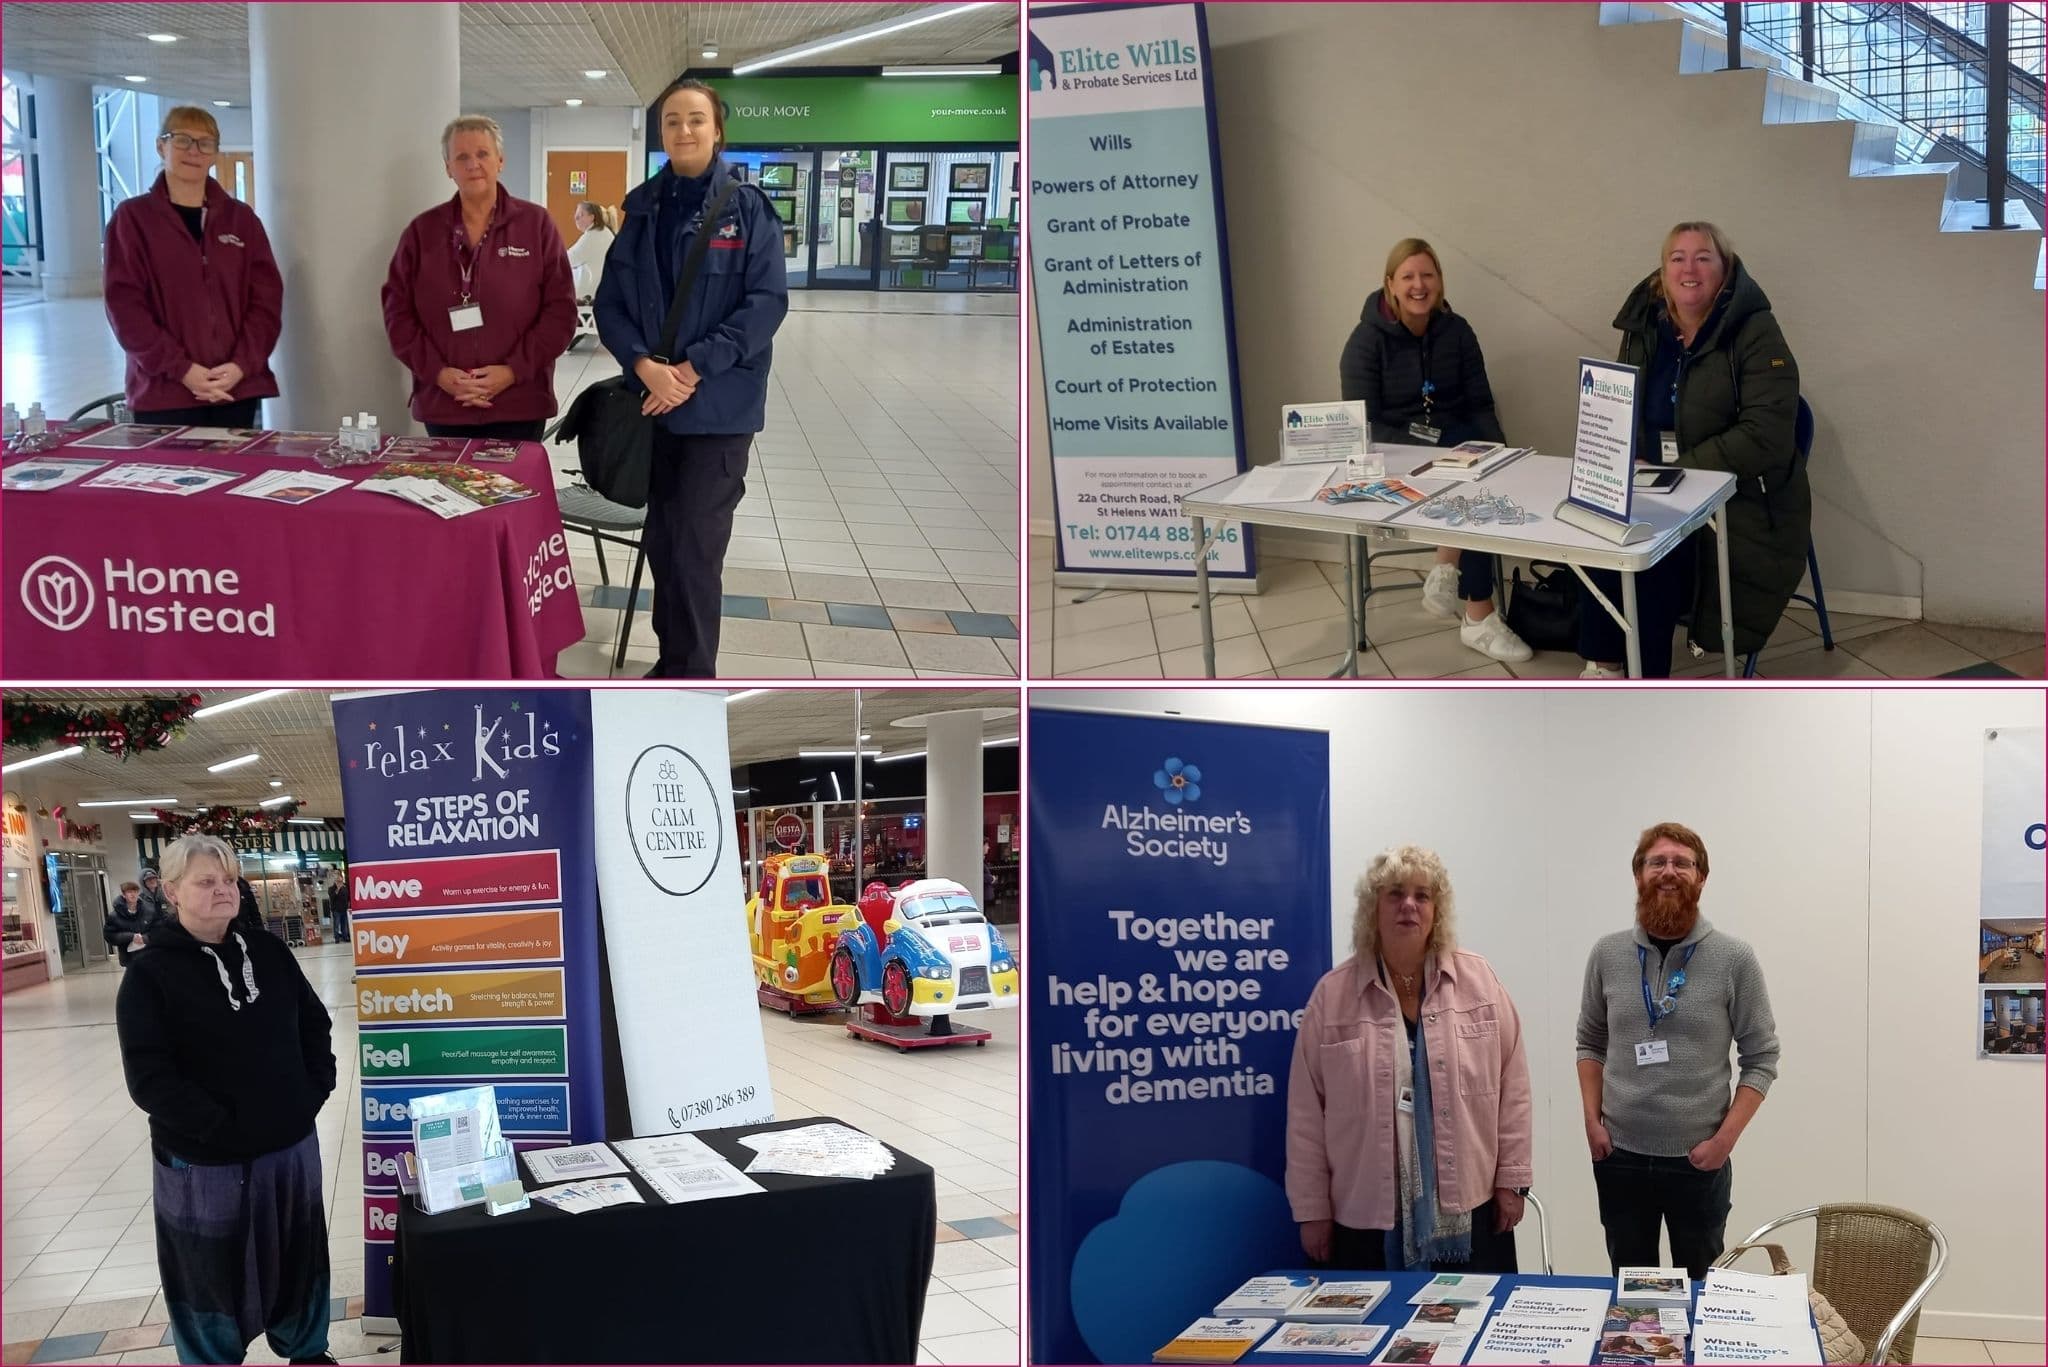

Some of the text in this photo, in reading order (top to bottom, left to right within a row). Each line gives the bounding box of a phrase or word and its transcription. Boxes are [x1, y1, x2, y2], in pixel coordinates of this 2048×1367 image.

[1060, 39, 1197, 74] Elite Wills
[1062, 68, 1197, 90] & Probate Services Ltd
[735, 106, 810, 117] YOUR MOVE
[931, 107, 1007, 118] your-move.co.uk
[1089, 134, 1132, 151] Wills
[1032, 174, 1198, 195] Powers of Attorney
[1047, 213, 1190, 233] Grant of Probate
[1044, 251, 1202, 272] Grant of Letters of
[1063, 276, 1189, 295] Administration
[1067, 315, 1192, 333] Administration
[1091, 340, 1175, 355] of Estates
[1055, 377, 1217, 394] Court of Protection
[1595, 380, 1633, 398] Elite Wills
[1052, 415, 1229, 431] Home Visits Available
[1077, 493, 1097, 503] 22a
[1100, 493, 1137, 504] Church
[1140, 494, 1171, 505] Road,
[1096, 507, 1109, 517] St
[1111, 508, 1146, 517] Helens
[1149, 508, 1178, 517] WA11
[1067, 524, 1100, 540] Tel:
[1105, 525, 1160, 541] 01744
[103, 558, 239, 595] Home
[107, 596, 275, 637] Instead
[364, 703, 561, 782] relax Kids
[652, 783, 686, 803] THE
[394, 789, 530, 822] 7 STEPS OF
[651, 807, 695, 826] CALM
[1102, 804, 1251, 834] Alzheimer’s
[387, 813, 539, 847] RELAXATION
[776, 826, 800, 836] SIESTA
[646, 830, 707, 851] CENTRE
[1127, 831, 1228, 866] Society
[354, 875, 422, 901] Move
[442, 887, 461, 896] Warm
[462, 889, 472, 897] up
[472, 886, 499, 895] exercise
[508, 884, 530, 893] energy
[1108, 910, 1275, 948] Together
[356, 929, 409, 959] Play
[431, 943, 452, 952] Activity
[453, 944, 475, 953] games
[476, 942, 485, 951] for
[486, 942, 506, 951] vitality,
[508, 940, 534, 950] creativity
[948, 935, 981, 953] 23
[1174, 948, 1290, 972] we are
[360, 987, 555, 1015] Stretch Stretching for balance, inner
[1048, 973, 1261, 1011] help & hope
[501, 1000, 527, 1009] strength
[1084, 1007, 1305, 1040] for everyone
[362, 1043, 410, 1068] Feel
[470, 1050, 499, 1059] massage
[500, 1049, 508, 1057] for
[509, 1049, 520, 1057] self
[492, 1057, 519, 1066] empathy
[519, 1057, 532, 1065] and
[1051, 1036, 1240, 1077] living with
[1105, 1066, 1274, 1105] dementia
[508, 1105, 537, 1113] improved
[521, 1097, 560, 1106] exercises for
[681, 1098, 713, 1122] 07380
[715, 1091, 734, 1111] 286
[736, 1085, 755, 1104] 389
[1712, 1284, 1744, 1292] What
[1703, 1314, 1757, 1322] vascular
[1704, 1306, 1737, 1314] What
[1496, 1322, 1590, 1332] Understanding
[1490, 1334, 1561, 1343] supporting
[1704, 1337, 1741, 1346] What
[1484, 1345, 1547, 1354] dementia
[1704, 1352, 1767, 1360] disease?
